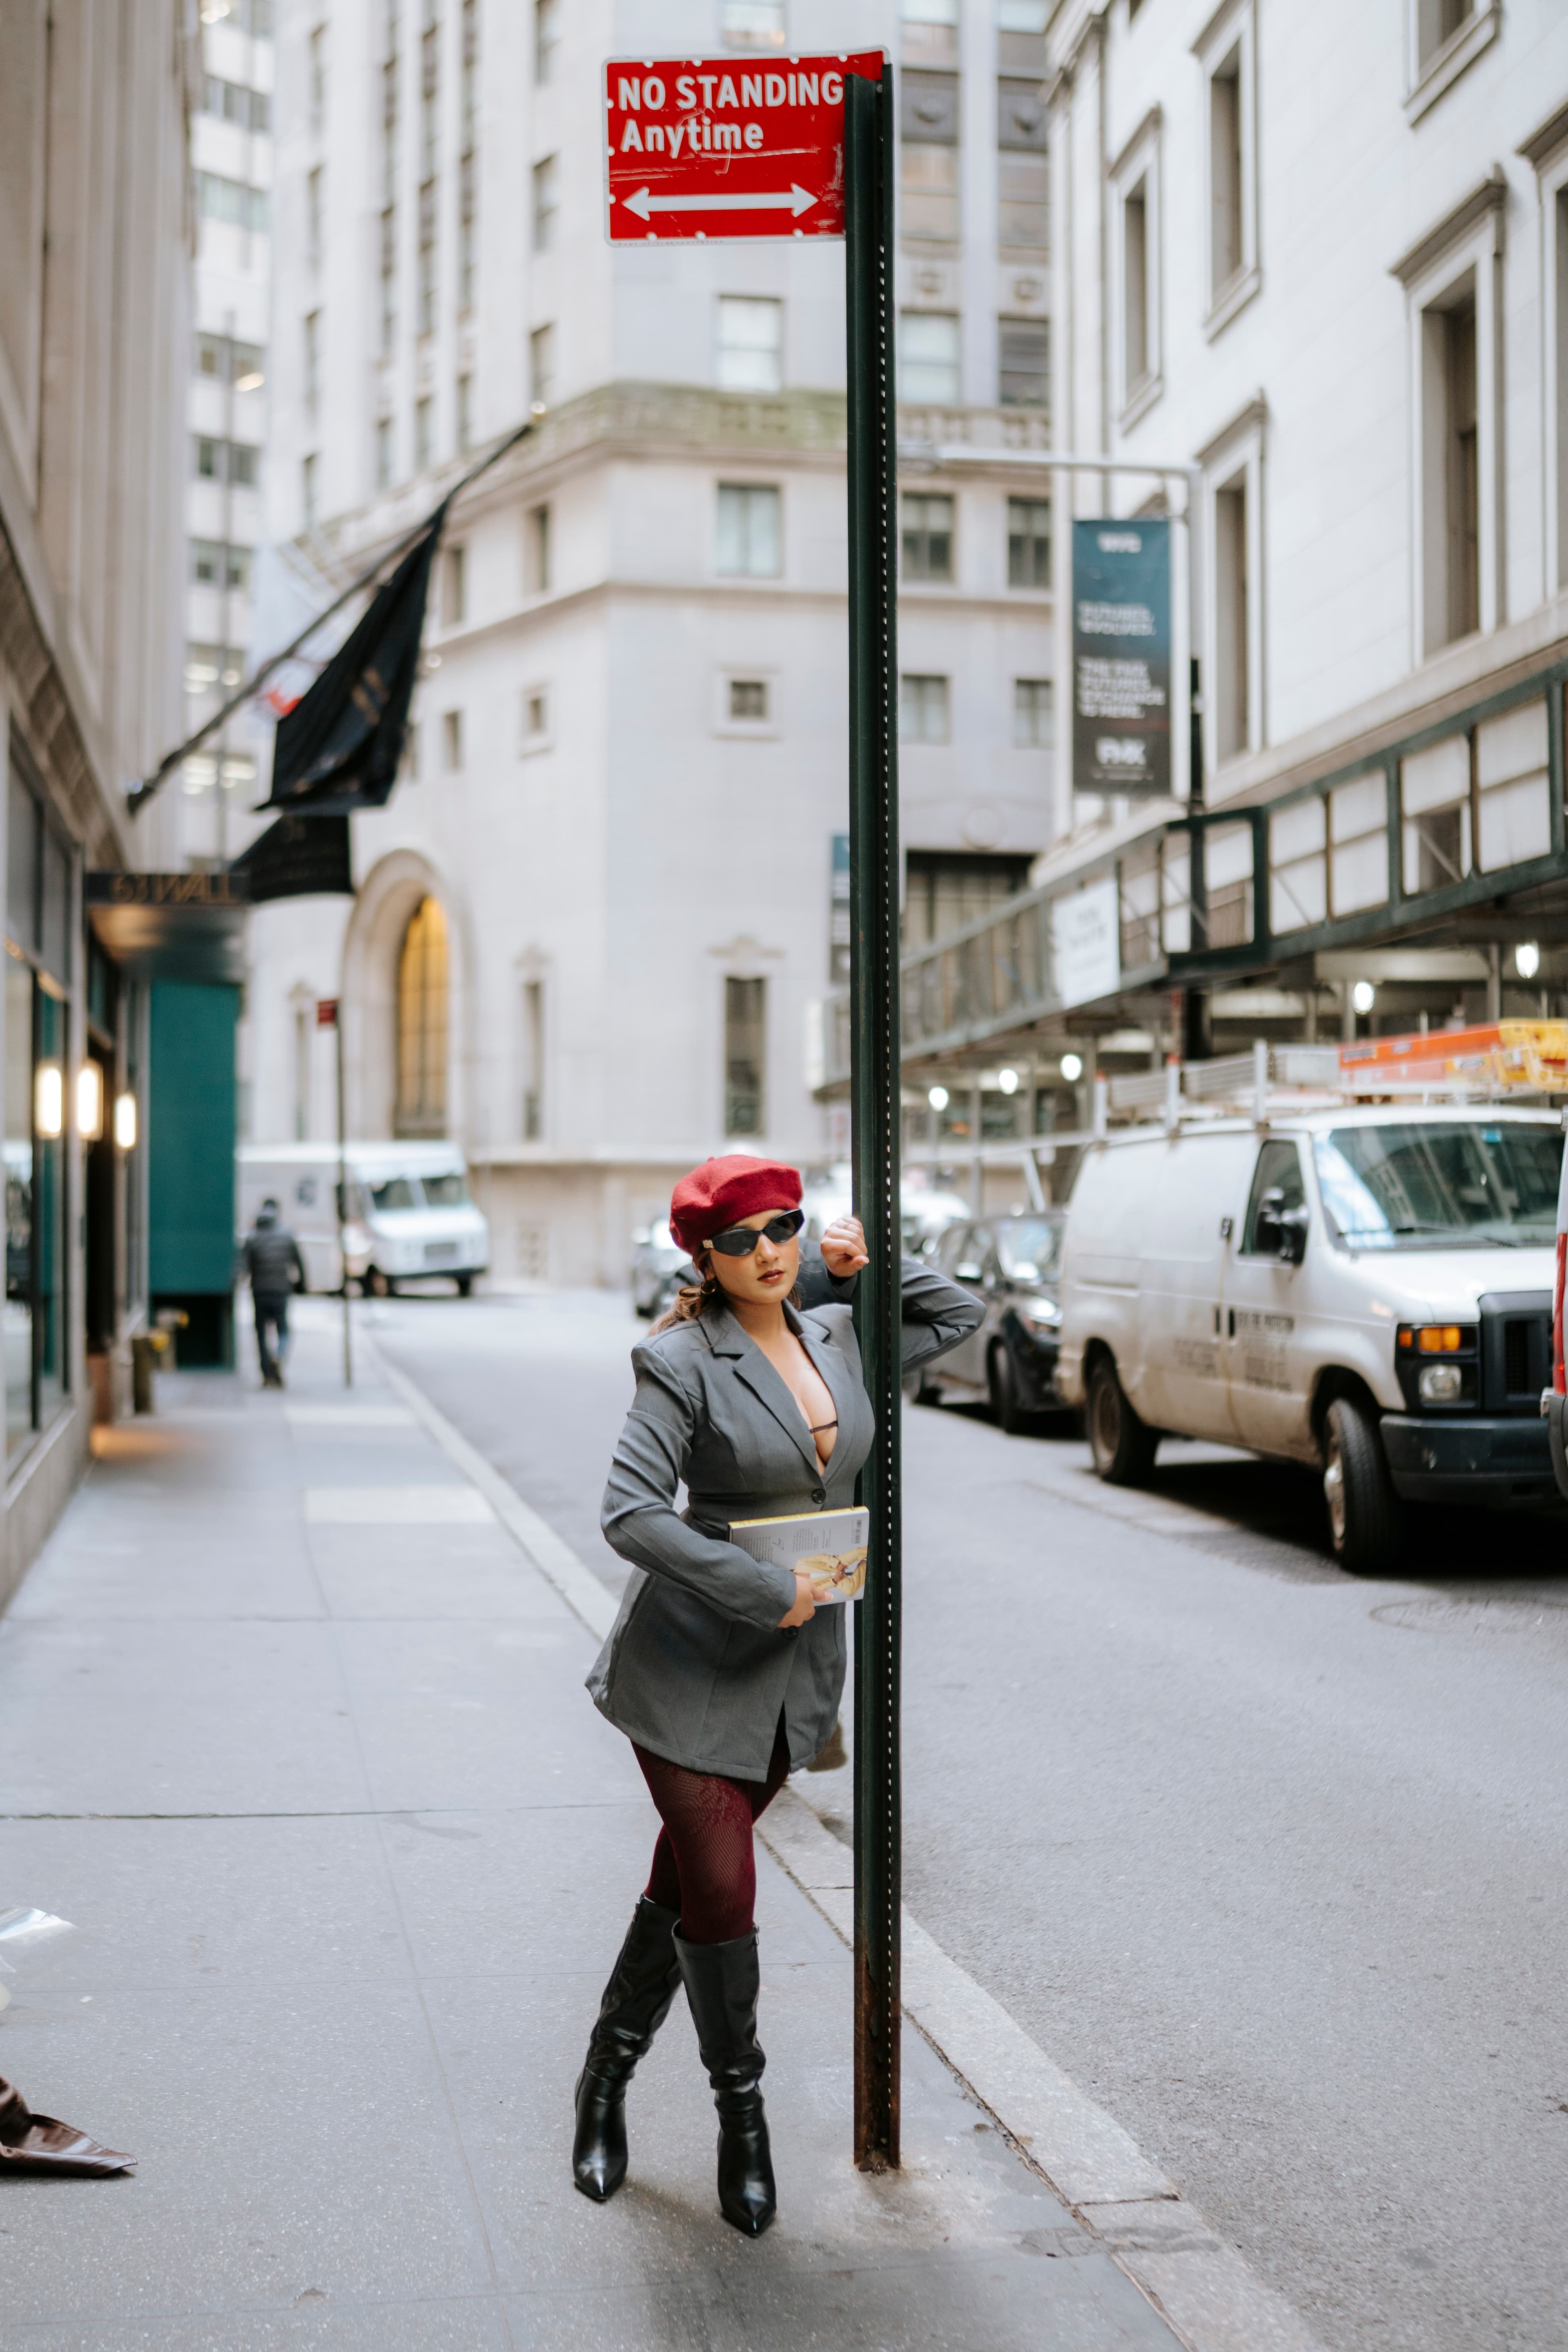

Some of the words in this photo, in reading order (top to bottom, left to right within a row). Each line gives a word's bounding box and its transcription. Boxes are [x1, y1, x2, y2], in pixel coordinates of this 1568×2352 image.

[618, 76, 666, 111] NO
[676, 71, 843, 109] STANDING
[621, 117, 764, 159] Anytime
